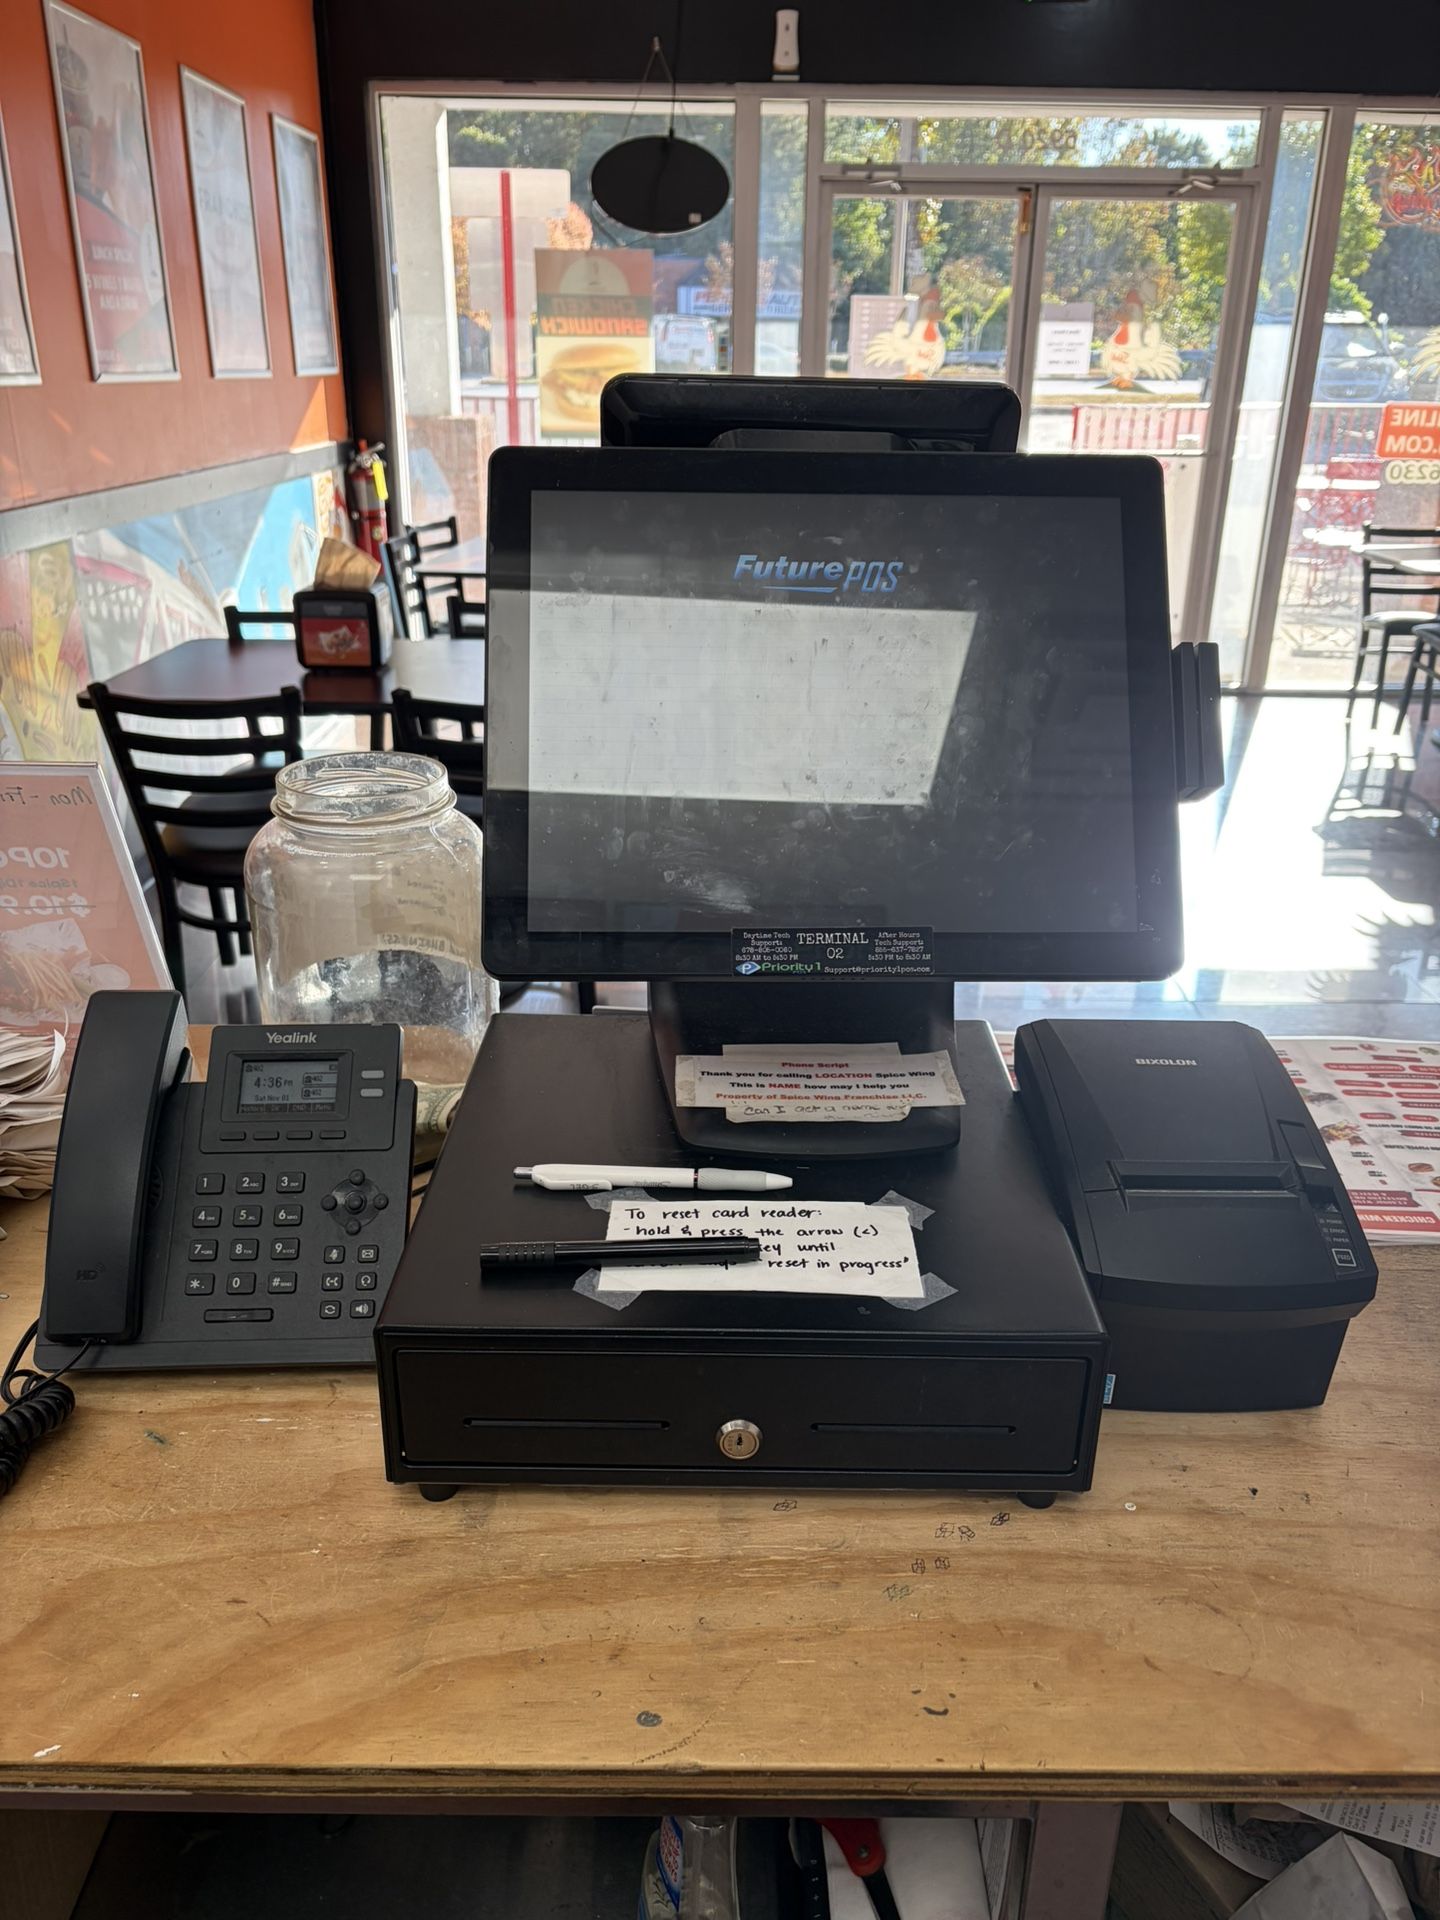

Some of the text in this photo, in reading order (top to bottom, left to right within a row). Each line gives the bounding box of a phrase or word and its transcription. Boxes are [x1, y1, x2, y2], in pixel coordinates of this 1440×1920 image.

[743, 931, 790, 939] Daytime Tech
[796, 932, 869, 945] TERMINAL
[789, 953, 799, 961] PM
[826, 947, 845, 959] 02
[922, 953, 932, 961] AM
[266, 1031, 317, 1045] Yealink
[1135, 1057, 1197, 1067] BIXOLON
[776, 1072, 812, 1080] calling
[875, 1072, 907, 1080] Spice
[907, 1070, 936, 1078] Wing
[254, 1076, 283, 1089] 4:36
[730, 1081, 753, 1089] This
[863, 1083, 887, 1091] help
[889, 1083, 910, 1091] you
[254, 1094, 266, 1102] Sat
[267, 1094, 280, 1102] Nov
[716, 1092, 763, 1101] Property
[780, 1093, 811, 1101] Spice
[743, 1106, 771, 1116] Can
[773, 1105, 786, 1114] I
[202, 1177, 208, 1188] 1
[242, 1176, 250, 1187] 2
[281, 1176, 289, 1187] 3
[197, 1210, 206, 1220] 4
[239, 1209, 247, 1220] 5
[278, 1209, 286, 1220] 6
[625, 1206, 822, 1221] To reset card reader:
[1383, 1214, 1437, 1225] CHICKEN
[635, 1225, 671, 1237] hold
[680, 1225, 692, 1236] &
[700, 1227, 744, 1240] press
[754, 1227, 785, 1238] the
[796, 1227, 844, 1237] arrow
[194, 1244, 202, 1255] 7
[235, 1243, 243, 1254] 8
[275, 1242, 283, 1253] 9
[797, 1241, 836, 1253] until
[768, 1258, 810, 1269] reset
[817, 1258, 830, 1268] in
[232, 1277, 241, 1288] 0
